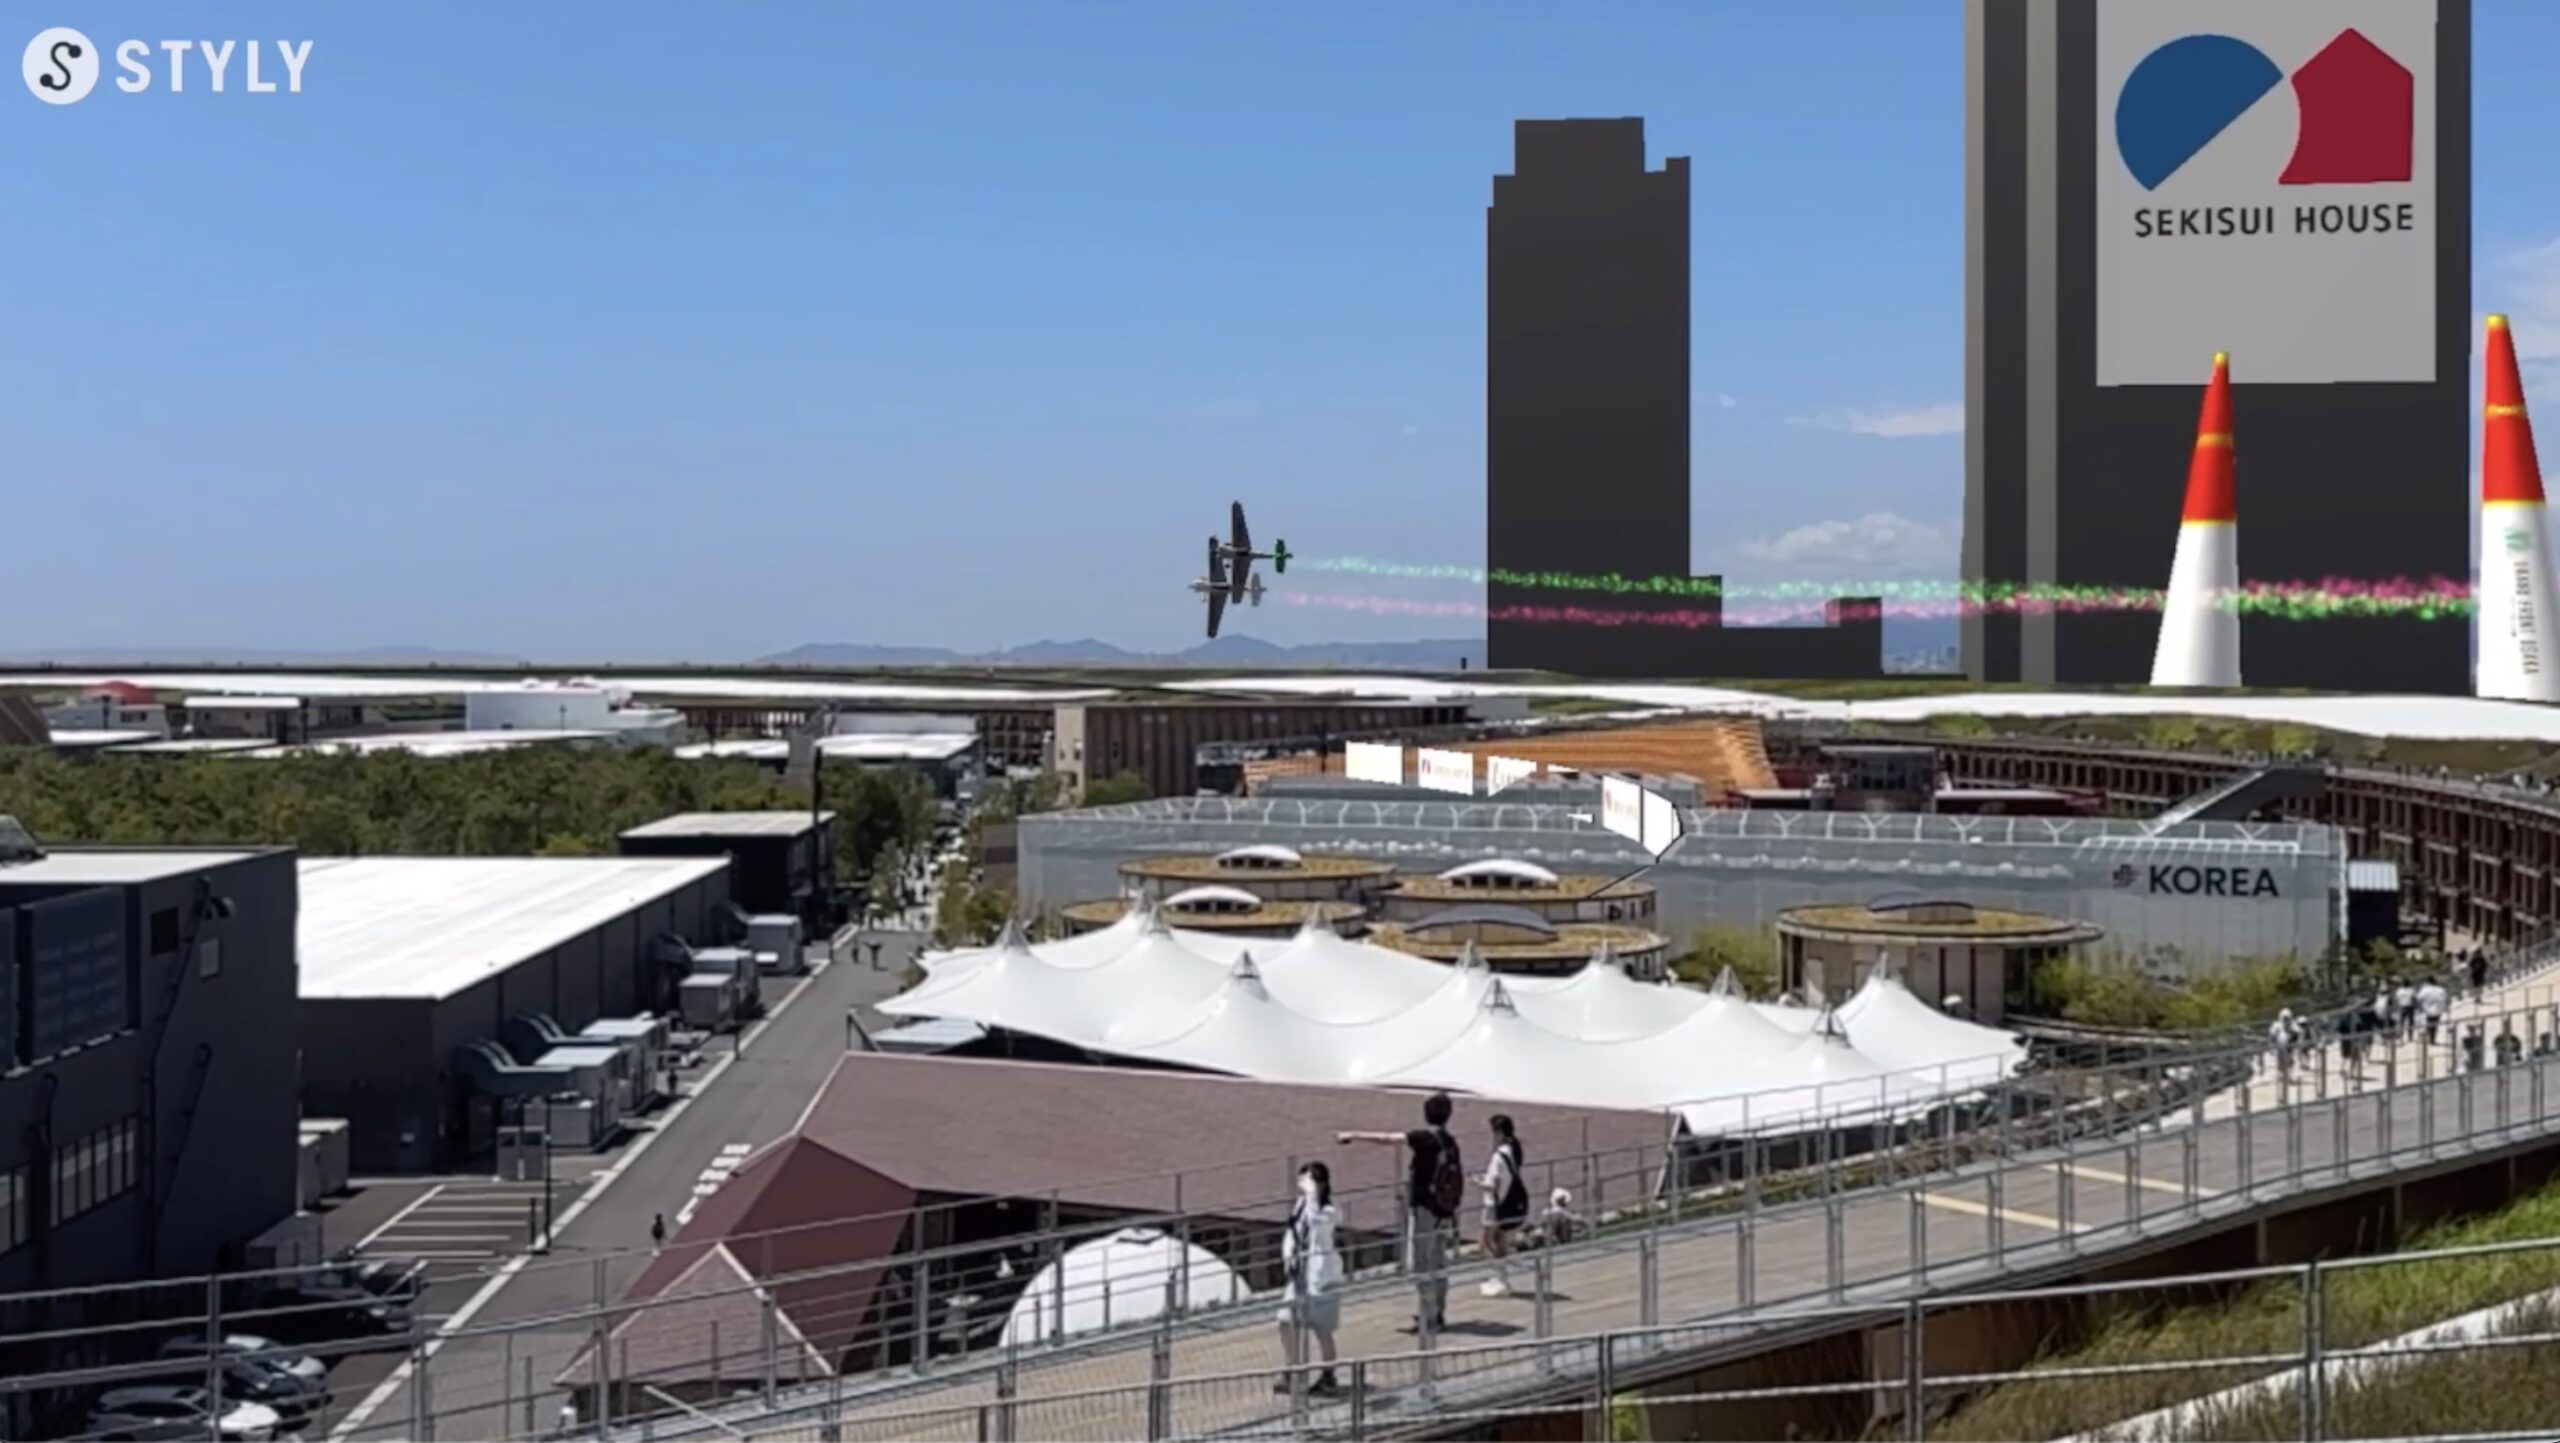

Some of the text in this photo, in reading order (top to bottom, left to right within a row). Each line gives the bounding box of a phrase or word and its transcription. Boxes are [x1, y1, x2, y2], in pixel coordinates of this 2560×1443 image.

[2134, 204, 2414, 237] SEKISUI HOUSE
[2149, 865, 2279, 897] KOREA
